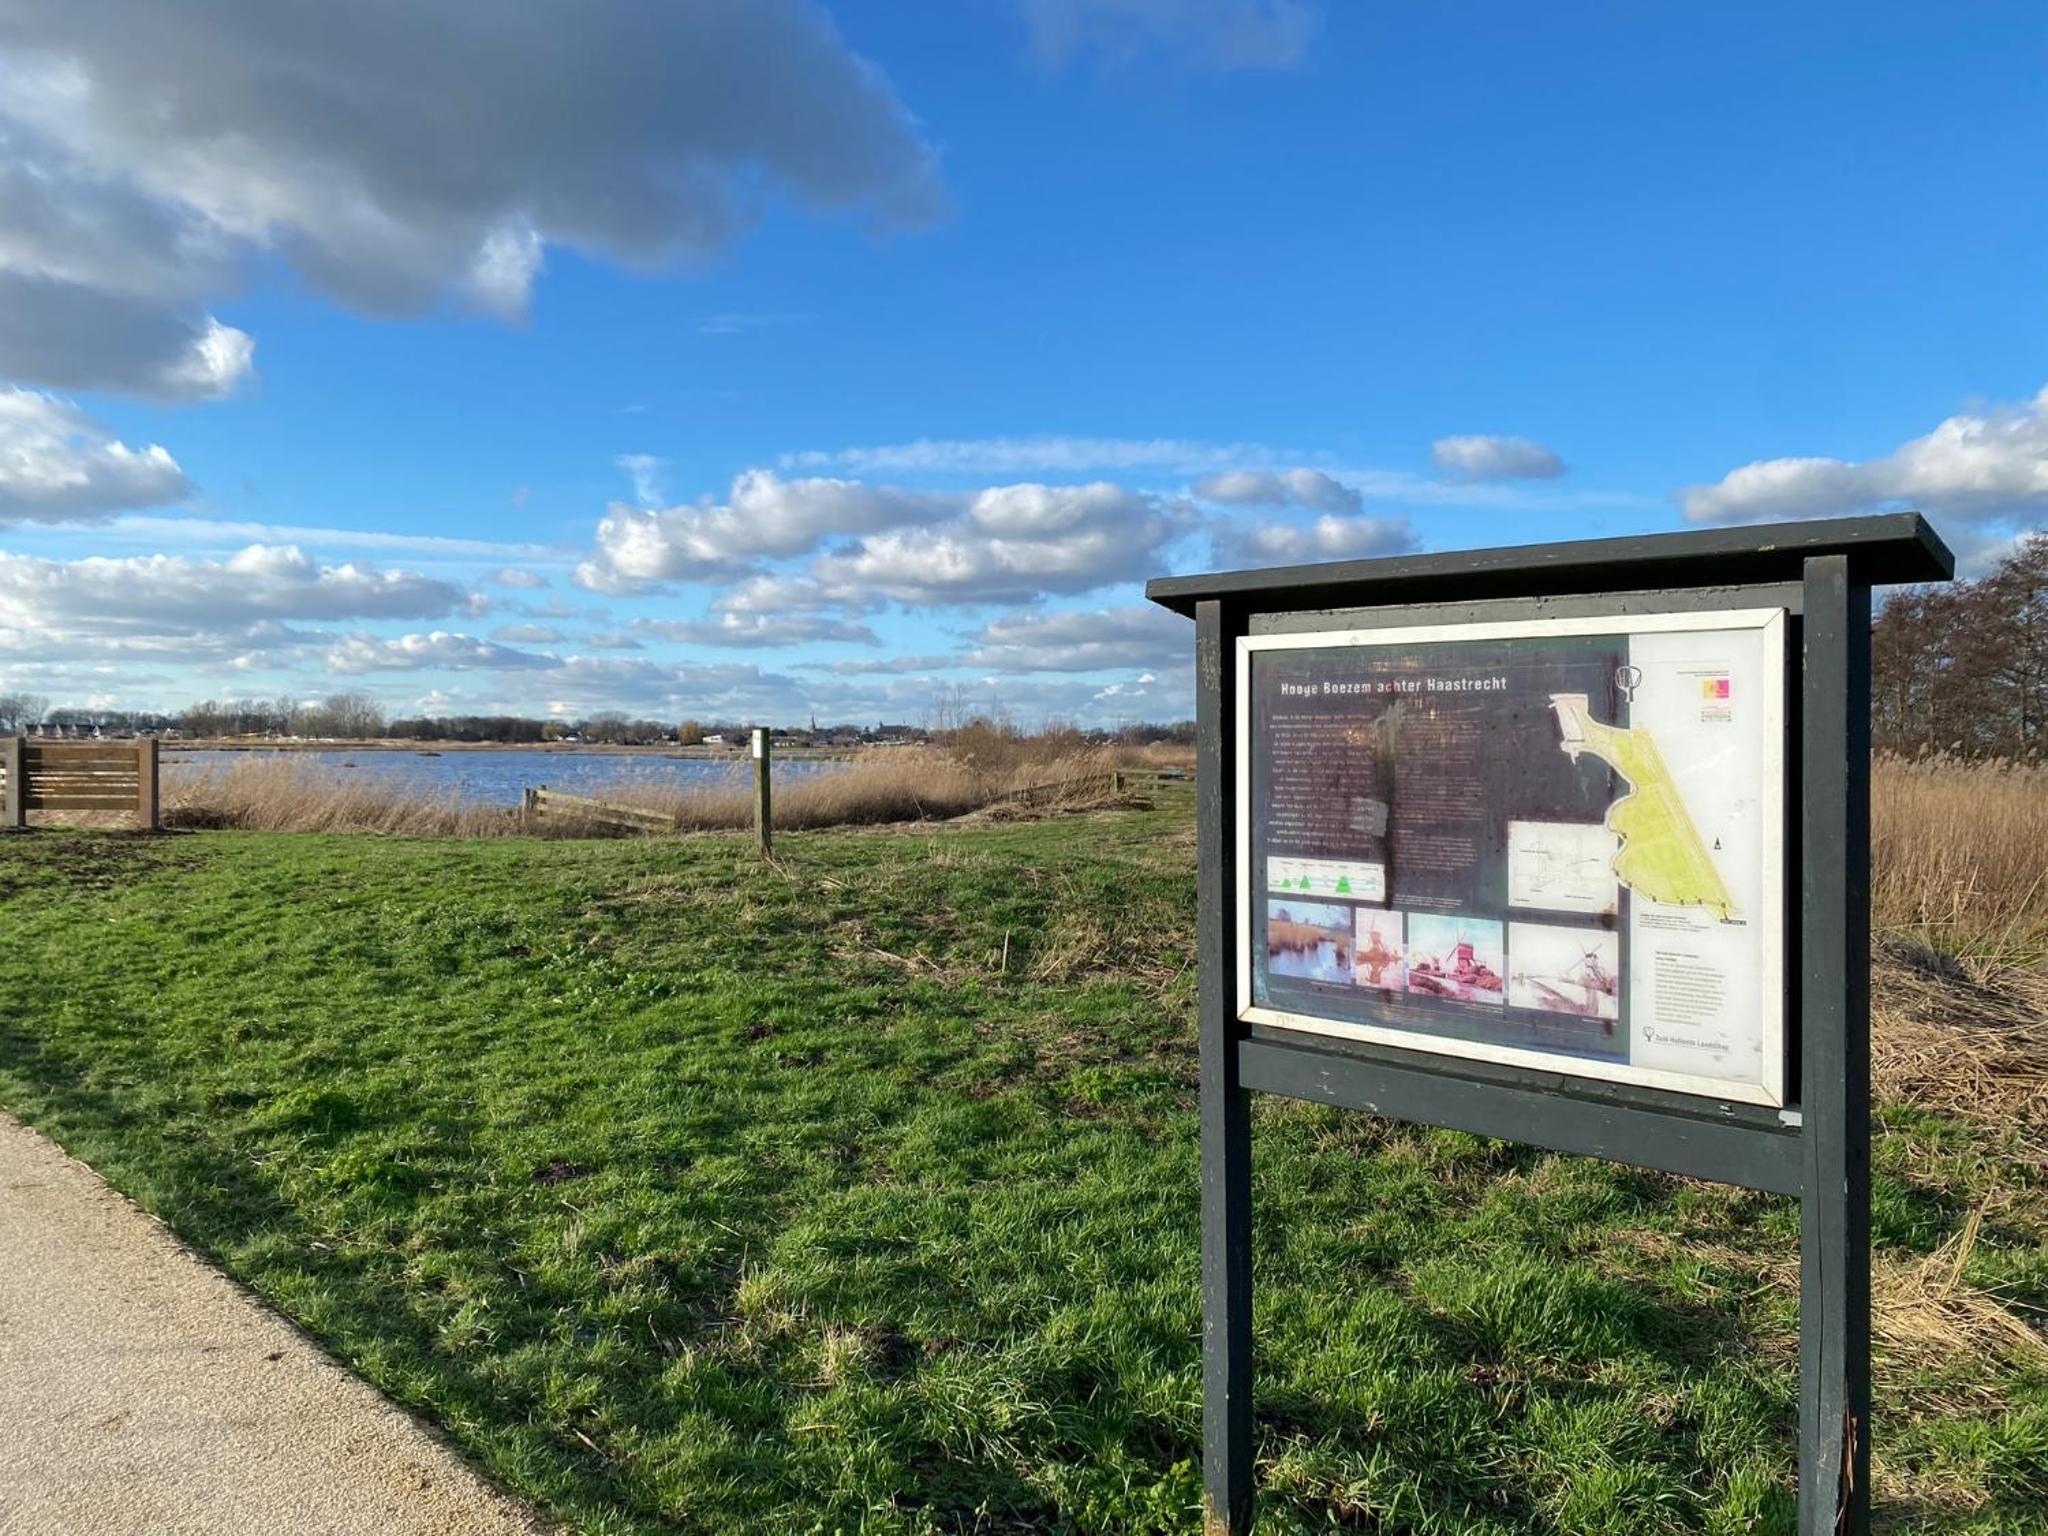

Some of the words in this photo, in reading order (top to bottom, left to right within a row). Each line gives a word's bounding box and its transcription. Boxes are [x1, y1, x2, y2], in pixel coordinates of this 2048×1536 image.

[1281, 683, 1318, 697] Hooge
[1324, 682, 1371, 694] Boezem
[1377, 680, 1421, 693] achter
[1427, 677, 1507, 691] Haastrecht
